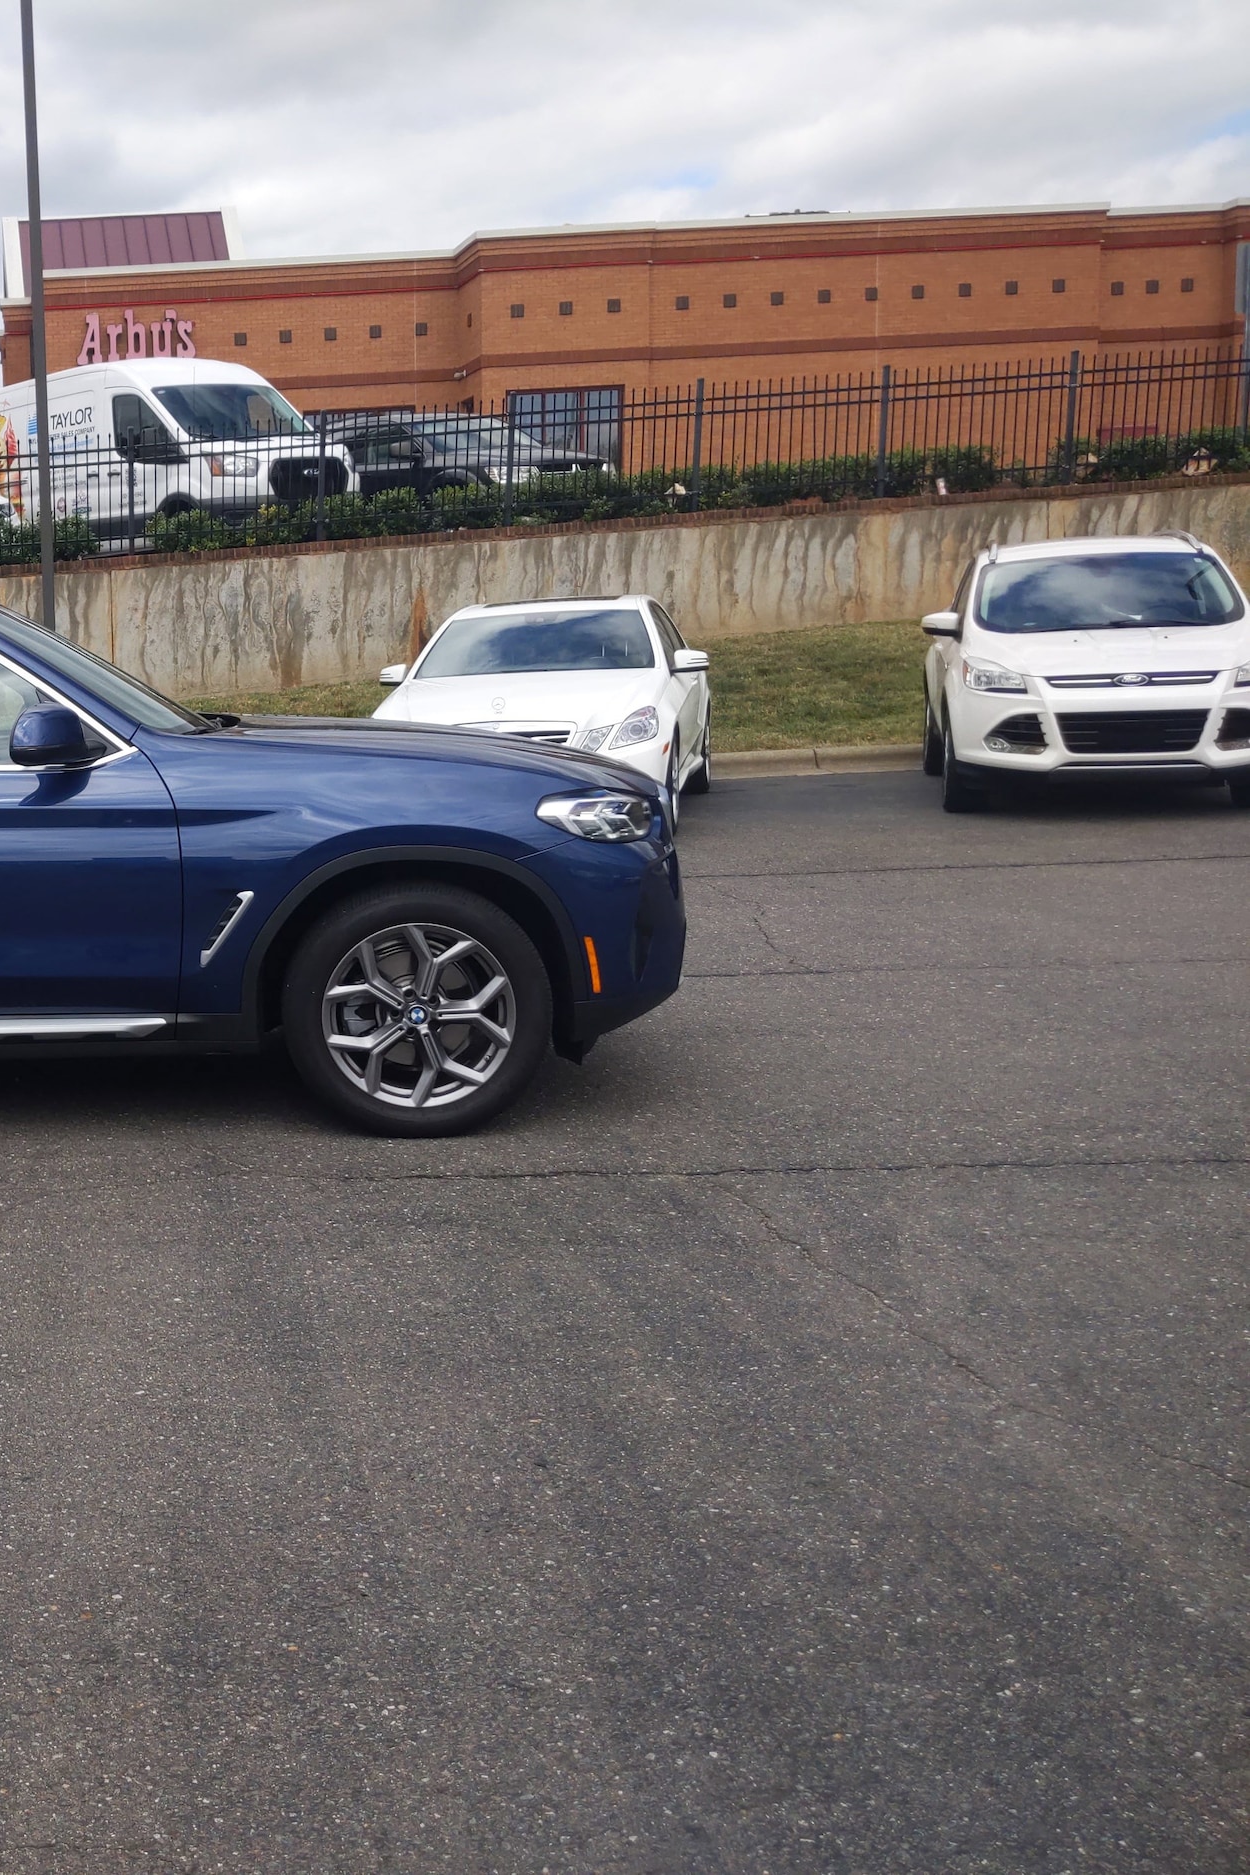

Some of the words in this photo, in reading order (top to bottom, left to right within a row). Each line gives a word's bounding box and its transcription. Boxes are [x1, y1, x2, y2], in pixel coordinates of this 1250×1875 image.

[50, 406, 92, 430] TAYLOR
[61, 430, 74, 438] SALES
[75, 426, 95, 436] COMPANY
